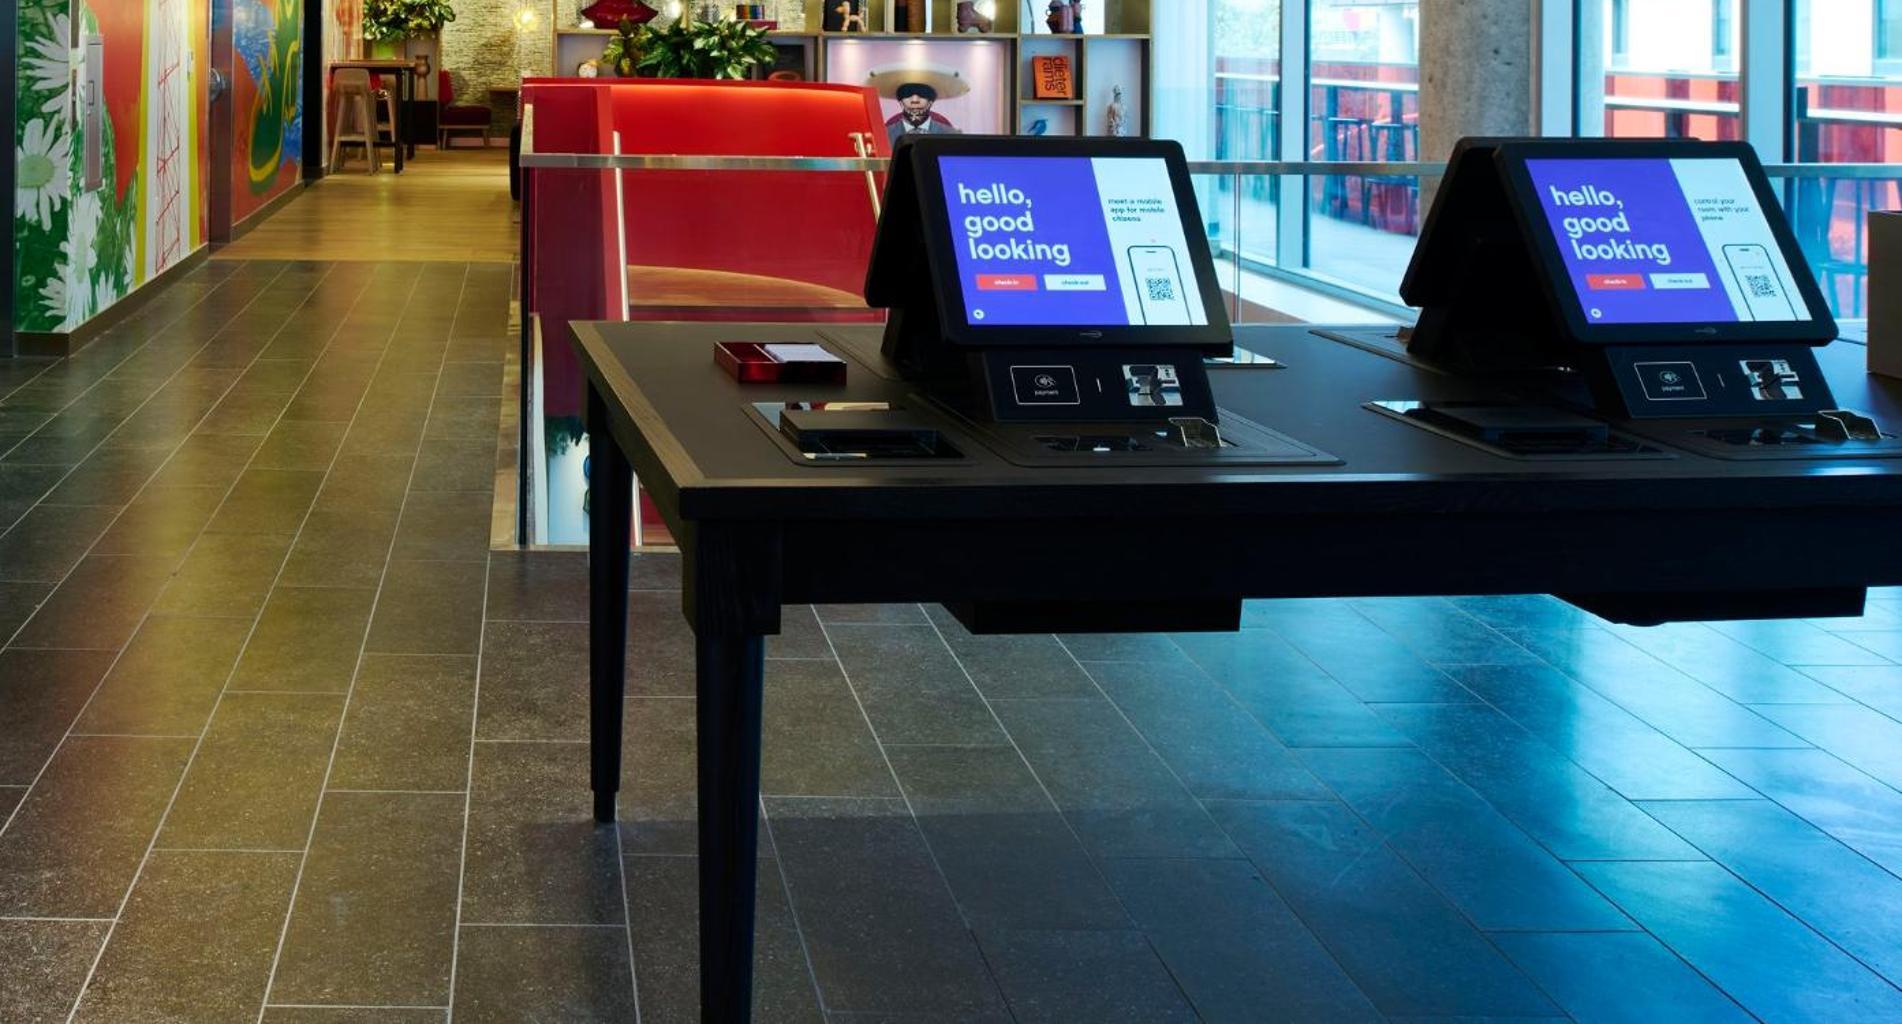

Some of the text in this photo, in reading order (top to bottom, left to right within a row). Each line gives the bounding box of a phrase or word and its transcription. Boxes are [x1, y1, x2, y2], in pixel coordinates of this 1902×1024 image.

[1042, 56, 1054, 91] rams
[1053, 56, 1067, 96] dieter
[958, 182, 1032, 209] hello,
[1549, 184, 1623, 209] hello,
[964, 210, 1034, 238] good
[1563, 211, 1631, 239] good
[968, 237, 1071, 266] looking
[1571, 238, 1671, 265] looking
